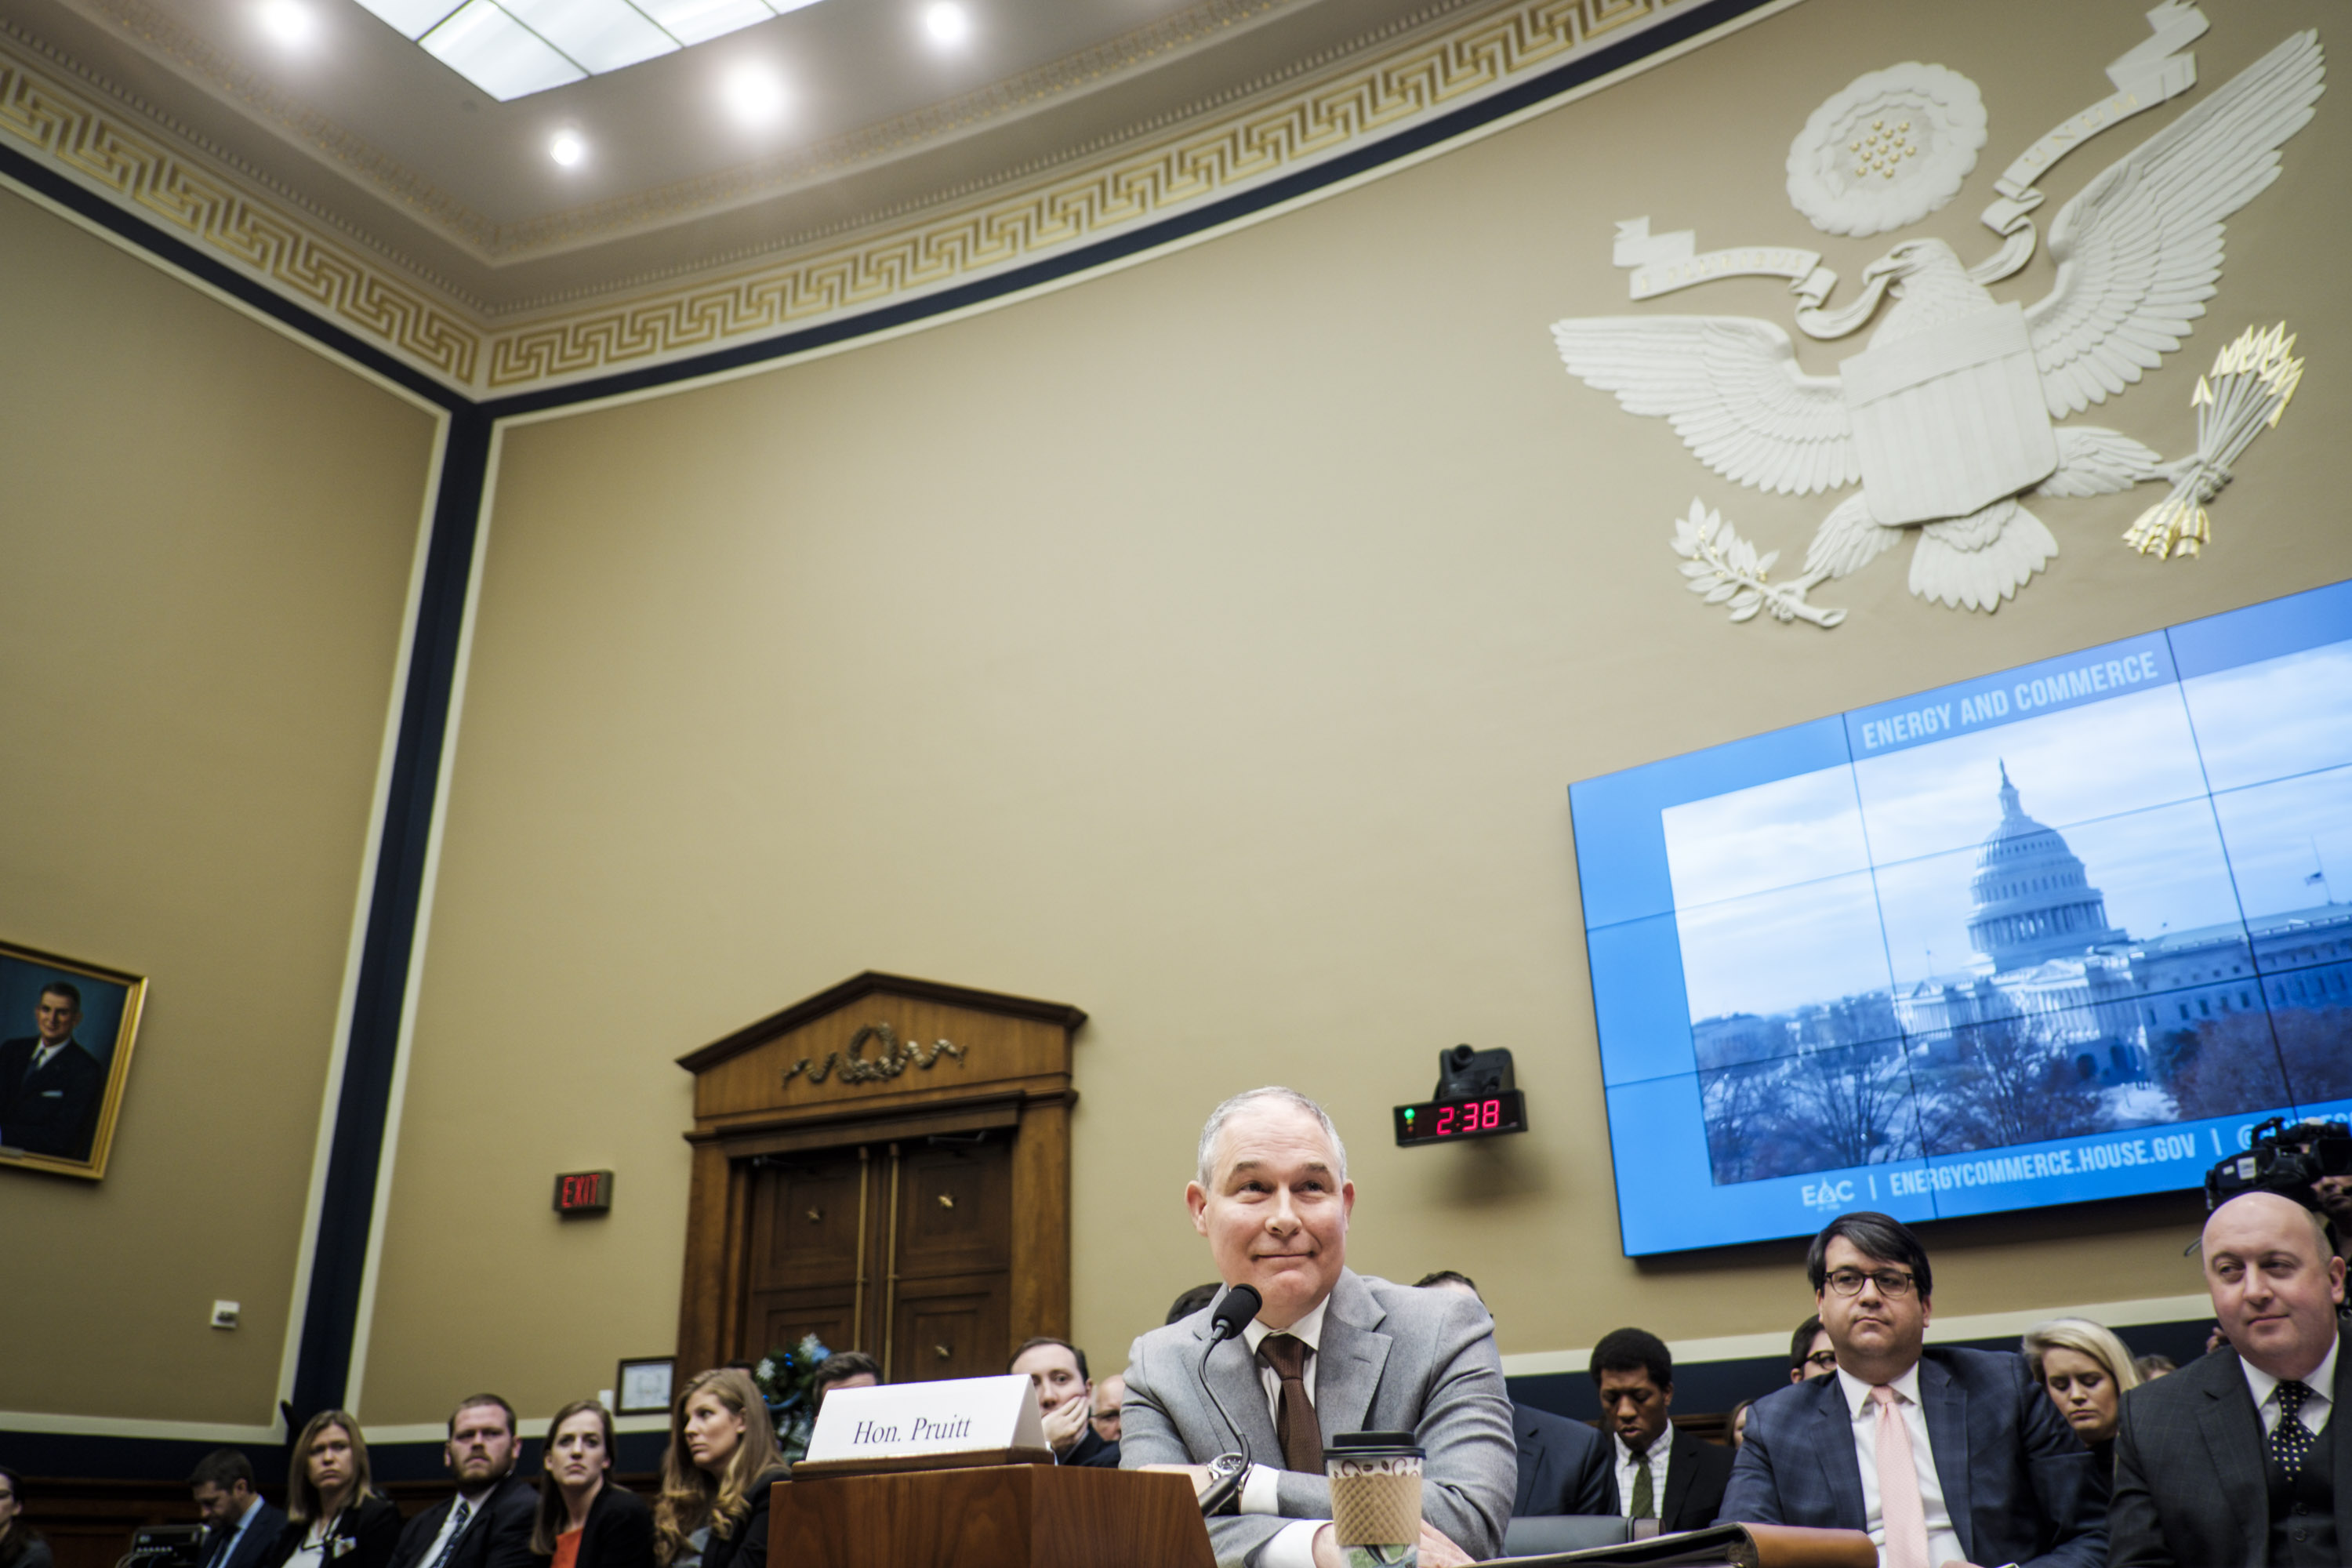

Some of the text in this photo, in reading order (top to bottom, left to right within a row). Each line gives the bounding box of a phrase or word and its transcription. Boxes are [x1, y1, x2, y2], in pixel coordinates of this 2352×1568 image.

[2024, 92, 2138, 168] UNUM
[1862, 651, 2158, 750] ENERGY AND COMMERCE
[1436, 1100, 1500, 1135] 2:38
[1890, 1132, 2197, 1197] ENERGYCOMMERCE.HOUSE.GOV
[561, 1174, 601, 1208] EXIT
[853, 1414, 971, 1444] Hon. Pruitt
